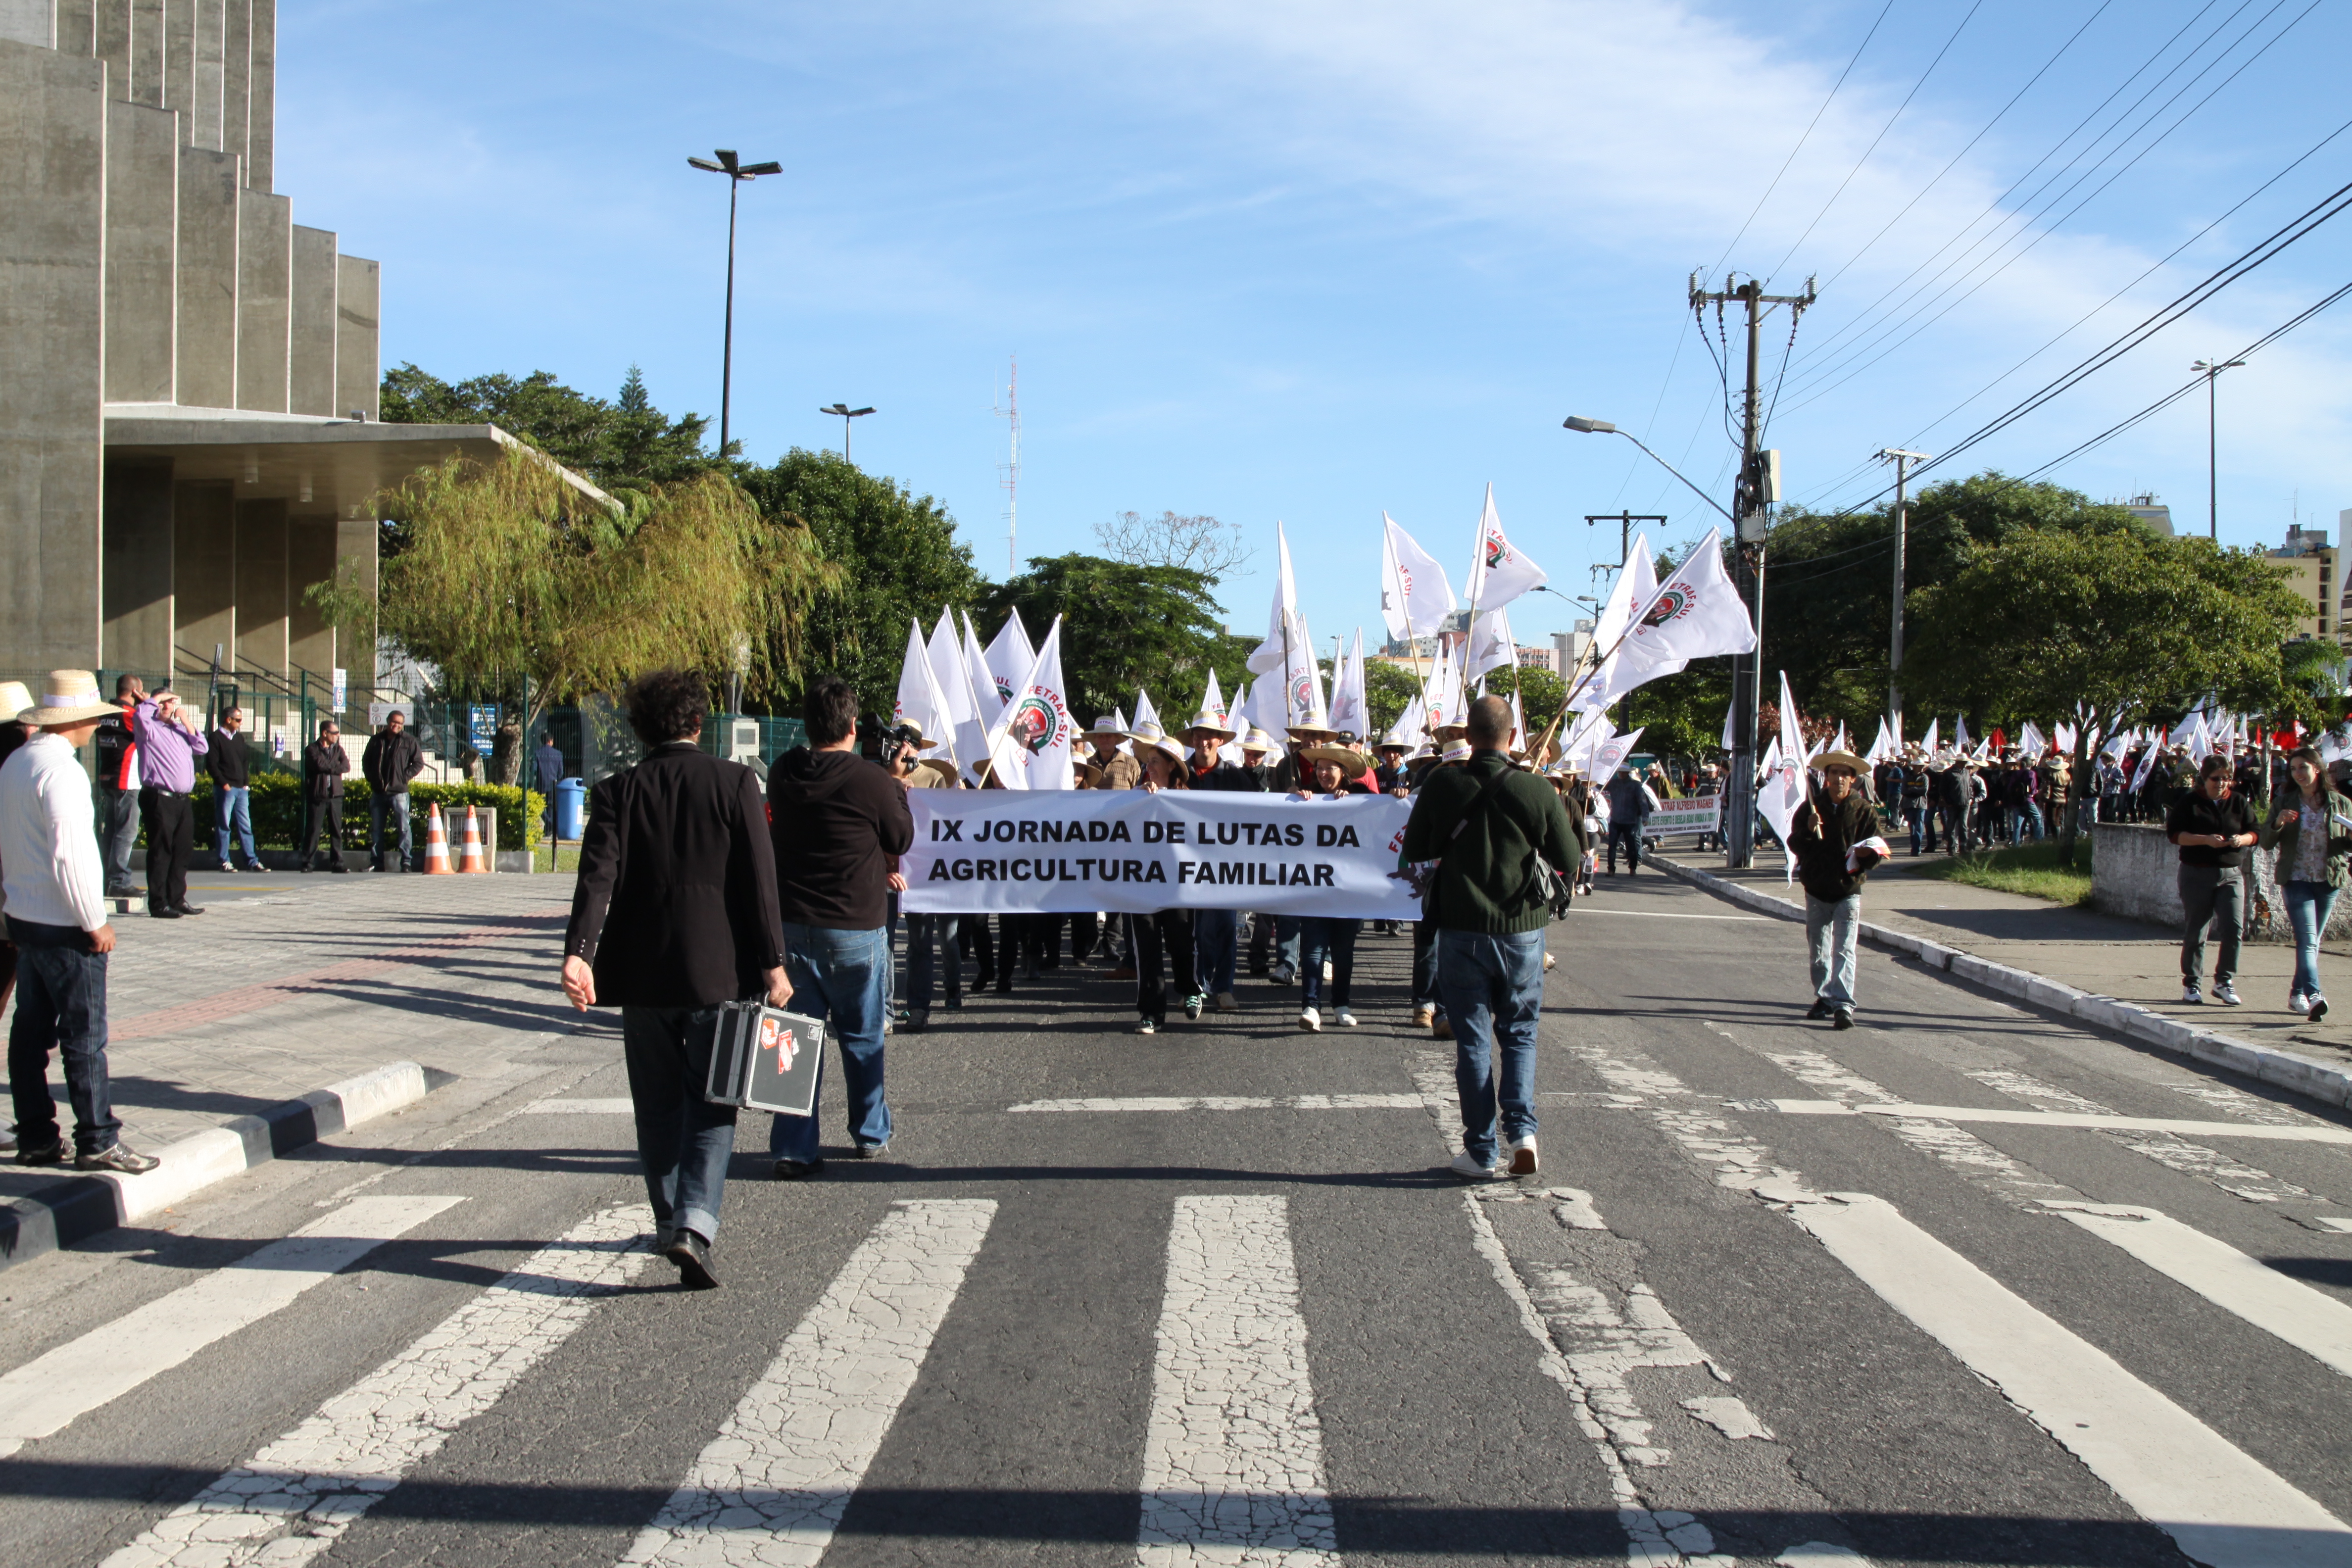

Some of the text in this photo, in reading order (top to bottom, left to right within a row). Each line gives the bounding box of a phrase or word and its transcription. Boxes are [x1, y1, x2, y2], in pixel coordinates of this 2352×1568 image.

[1668, 583, 1697, 620] ETRAF-SUL
[992, 676, 1010, 688] UL
[1025, 700, 1054, 741] AGRICULTURA FAMILIAR
[1028, 686, 1068, 748] FETRAF-SUL
[1660, 798, 1714, 812] NTRAF ALFREDO WAGNER
[931, 820, 1360, 848] IX JORNADA DE LUTAS DA
[928, 859, 1334, 887] AGRICULTURA FAMILIAR
